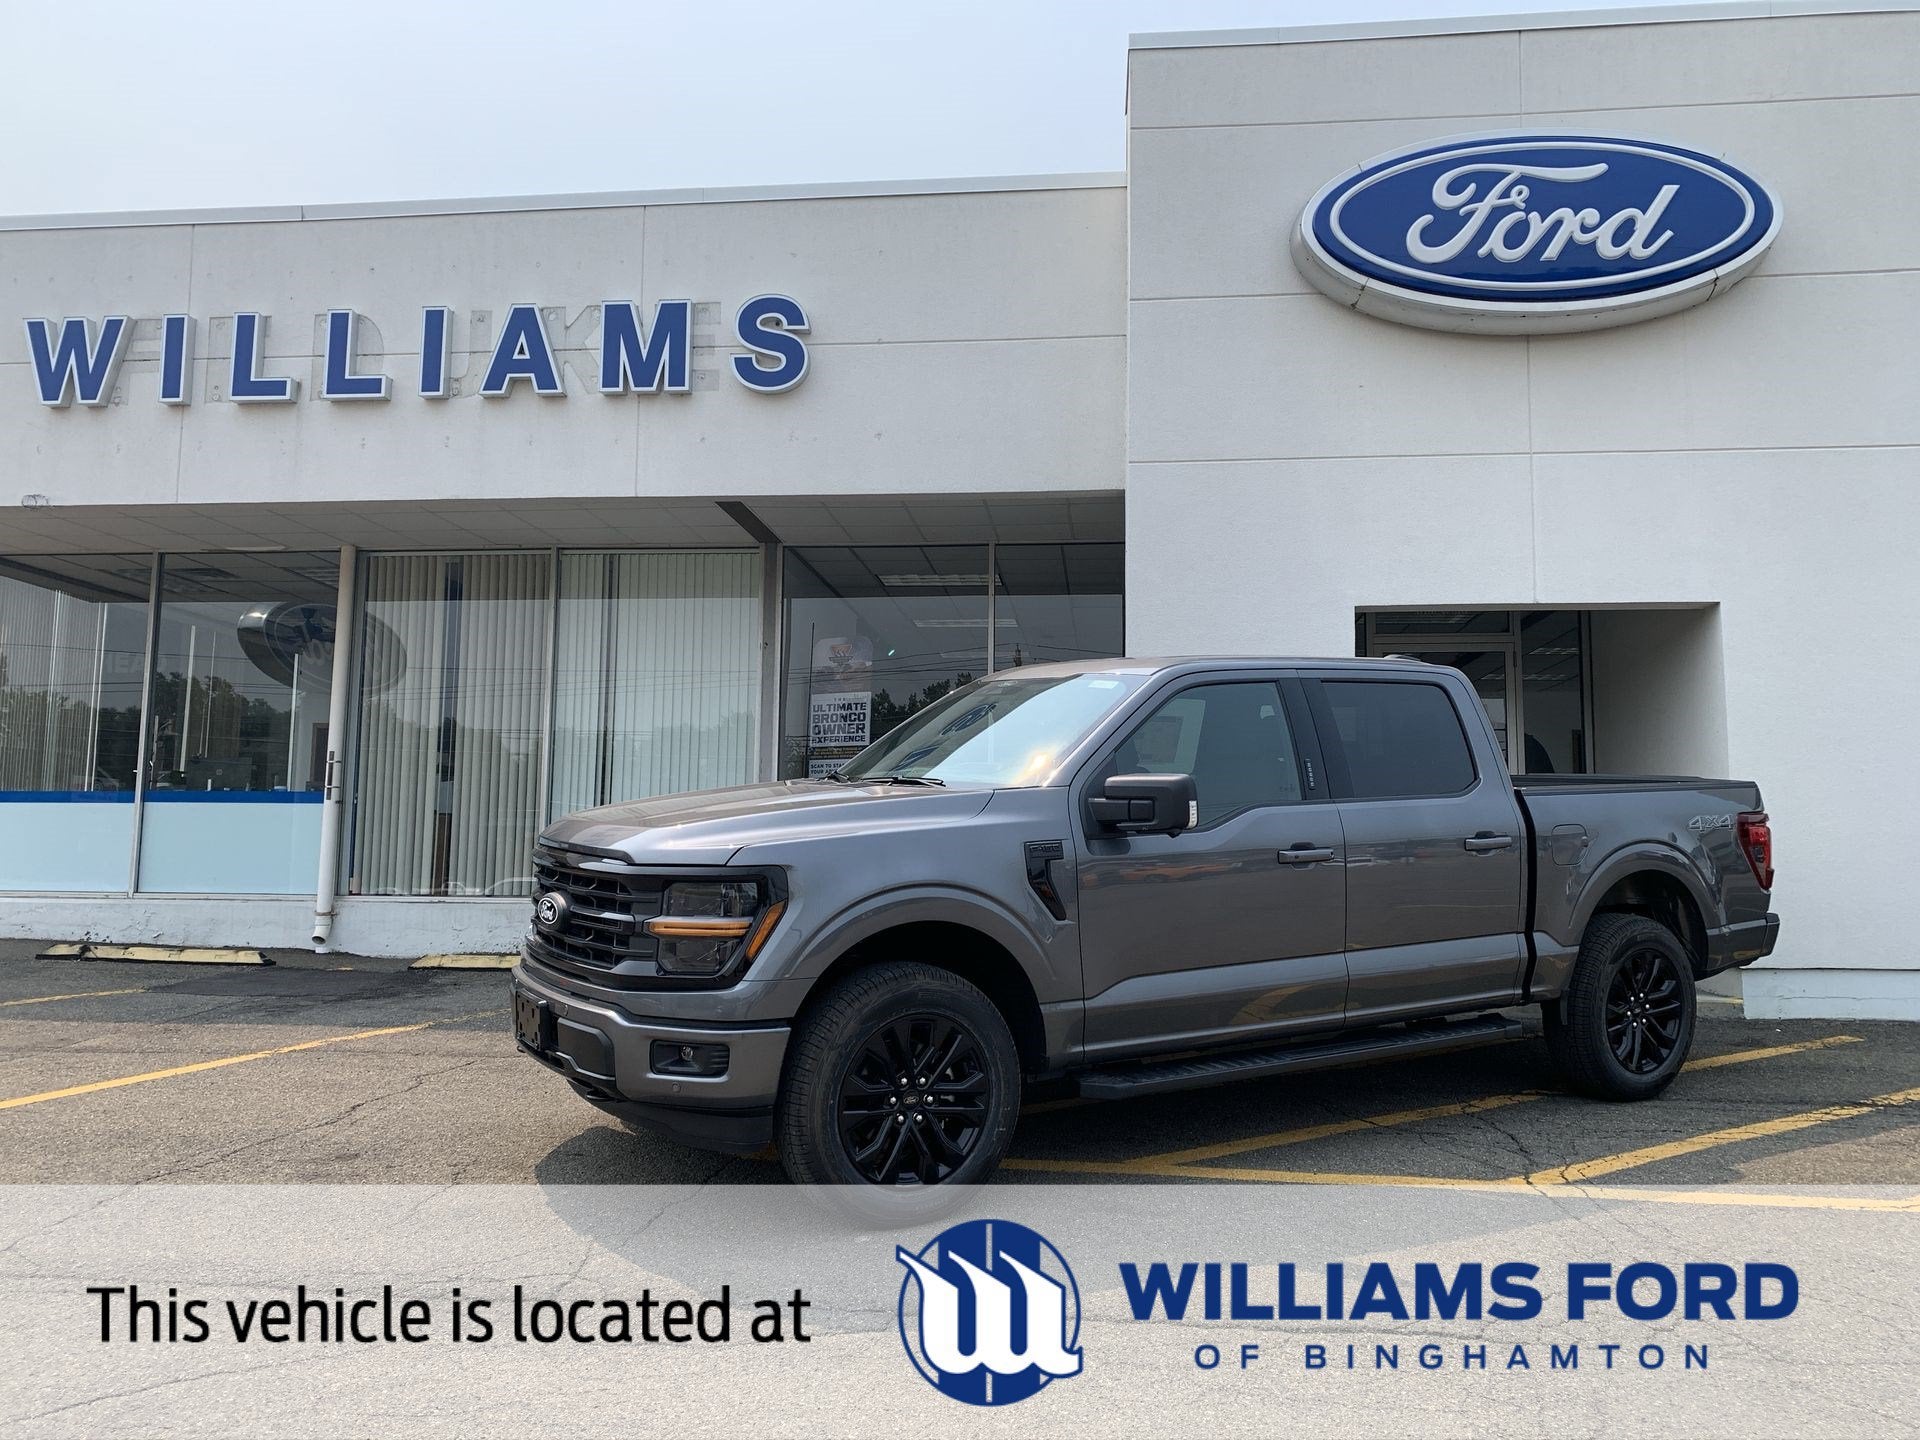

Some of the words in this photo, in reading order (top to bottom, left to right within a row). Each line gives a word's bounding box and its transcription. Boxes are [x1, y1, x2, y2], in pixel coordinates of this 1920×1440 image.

[1406, 162, 1680, 263] Ford
[23, 294, 812, 405] WILLIAMS
[812, 702, 867, 712] ULTIMATE
[812, 712, 867, 723] BRONCO
[812, 723, 866, 735] OWNER
[812, 735, 866, 743] EXPERIENCE
